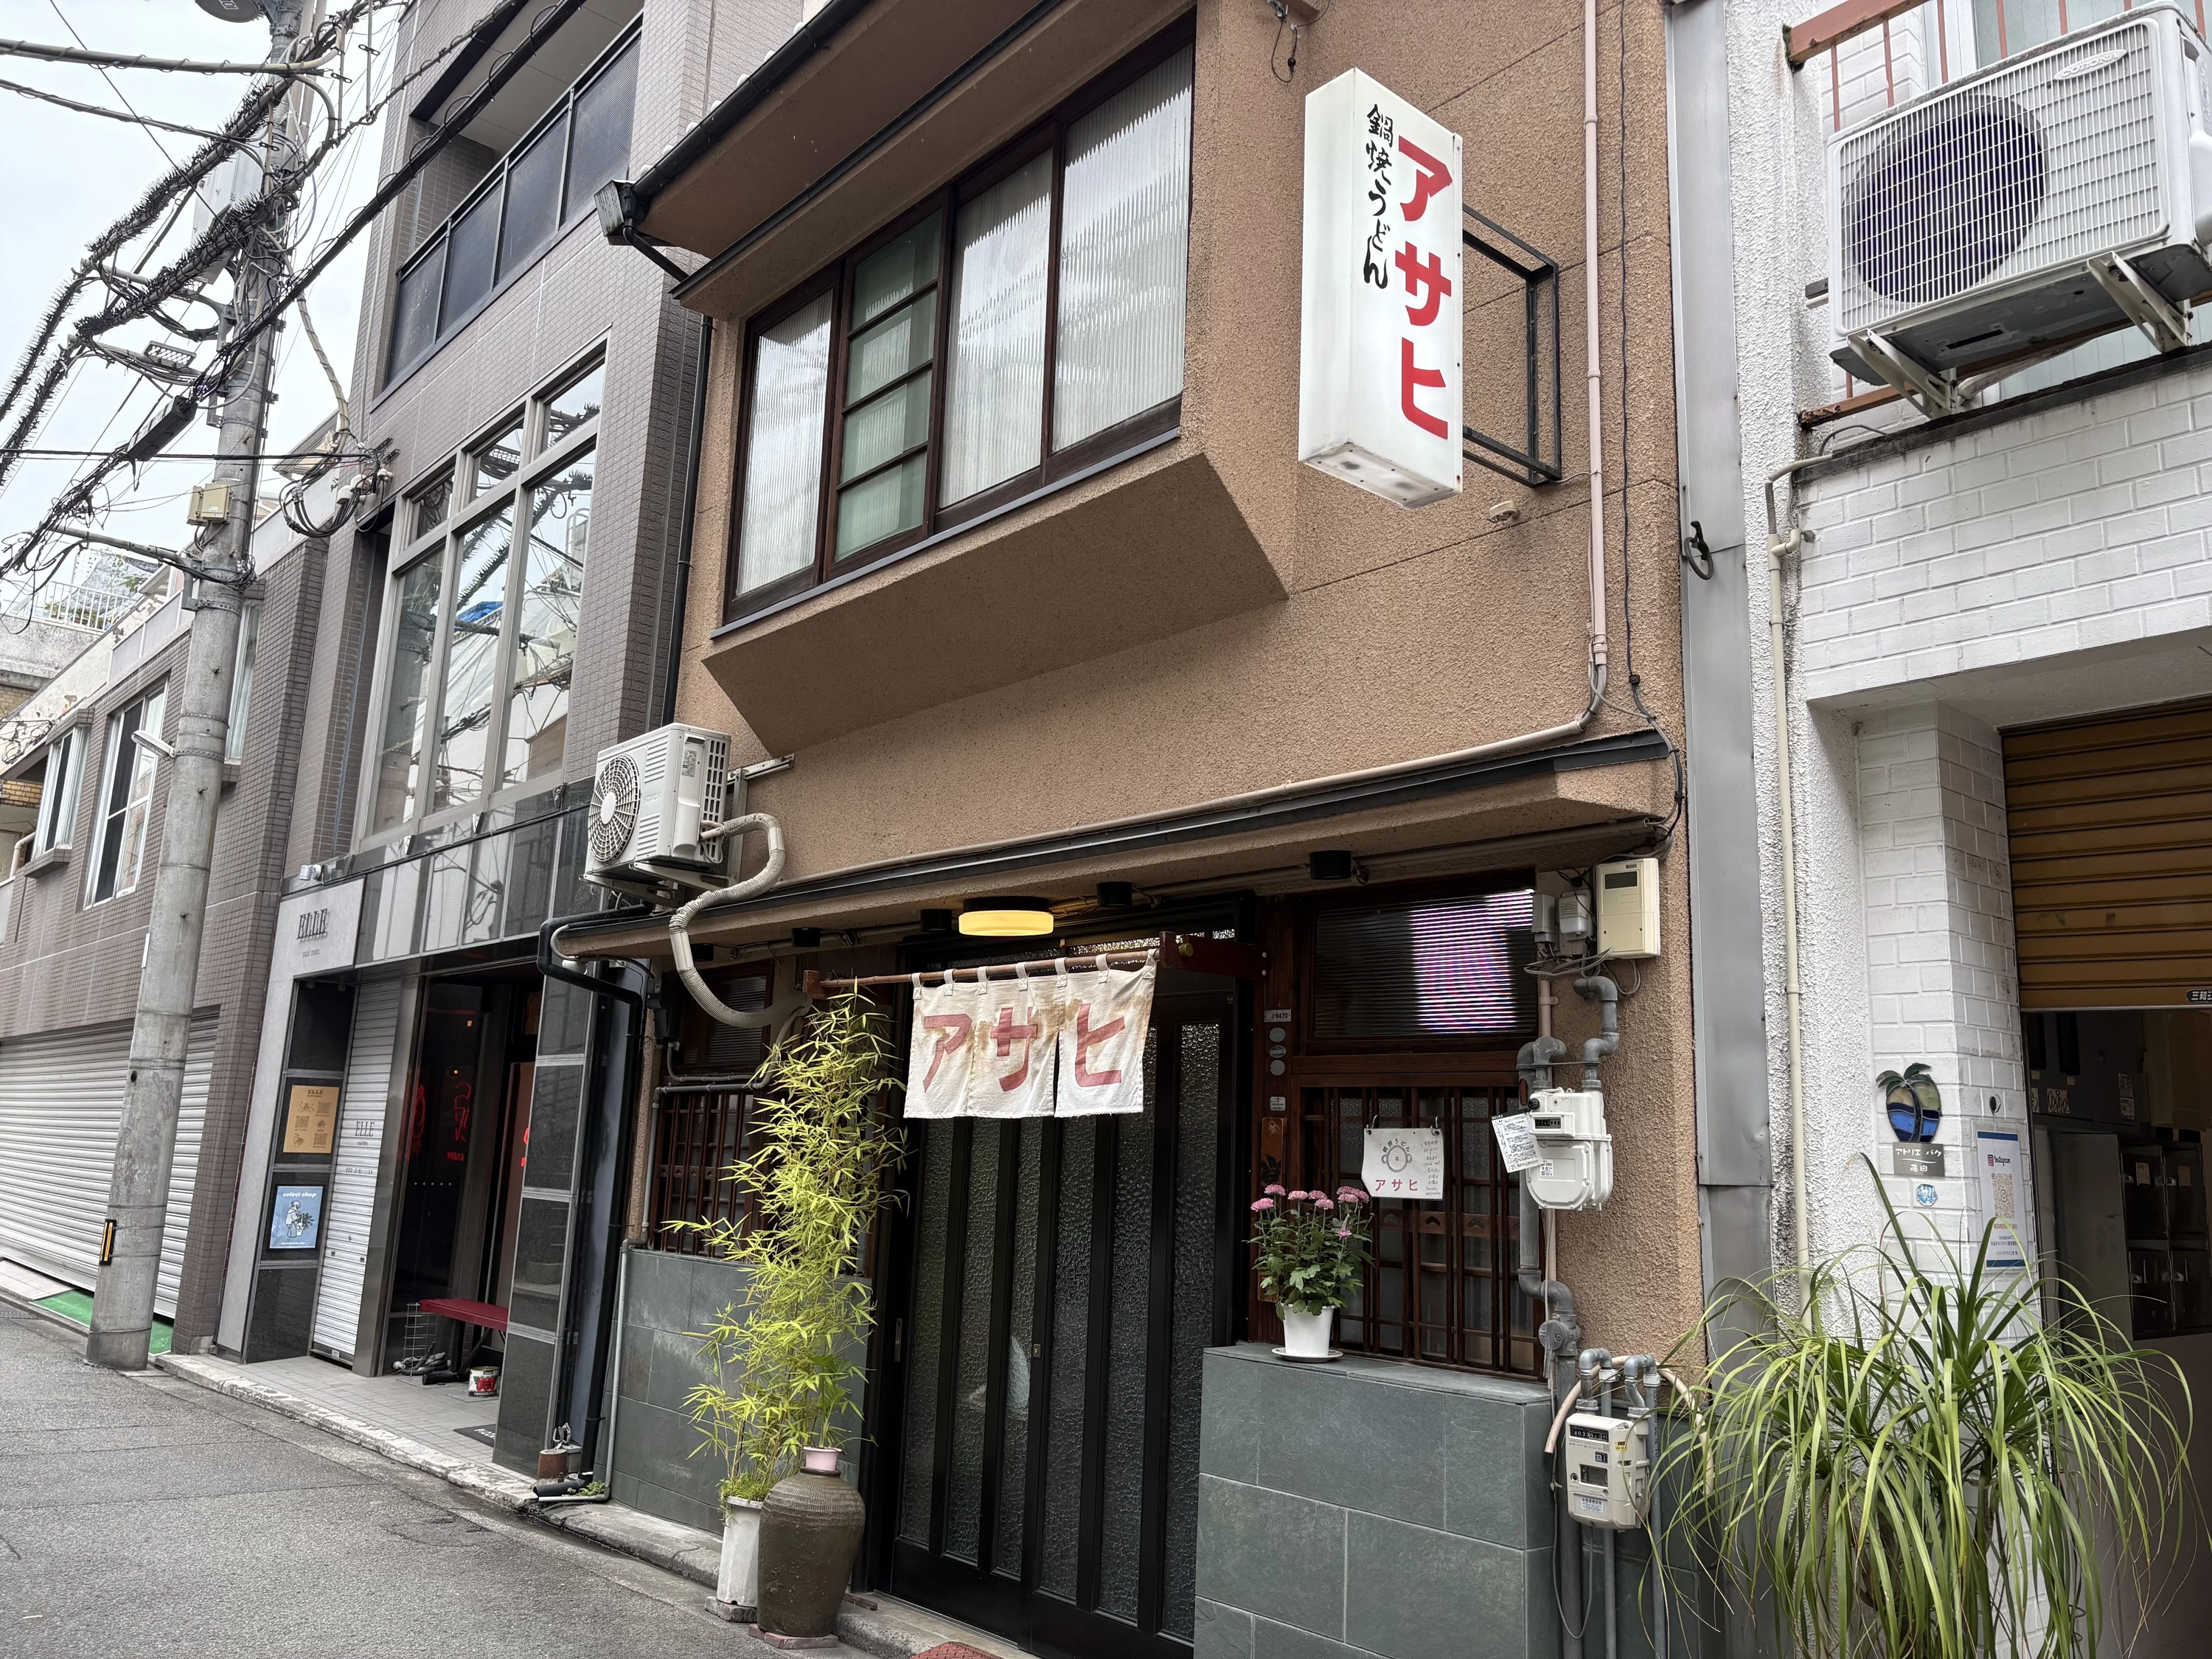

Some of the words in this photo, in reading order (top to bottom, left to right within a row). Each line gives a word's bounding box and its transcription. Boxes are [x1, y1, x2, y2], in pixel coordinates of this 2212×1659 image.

[2062, 52, 2118, 77] CORONA
[1363, 102, 1394, 291] 鍋焼うどん
[1394, 134, 1453, 441] アサヒ
[296, 908, 329, 941] ELLE
[923, 1002, 1126, 1094] アサヒ
[355, 1121, 375, 1137] ELLE
[1895, 1148, 1921, 1156] アトリエ
[1926, 1149, 1942, 1157] バク
[1994, 1155, 2011, 1166] Instagram
[1910, 1164, 1928, 1172] 藤田
[1375, 1179, 1418, 1192] アサヒ
